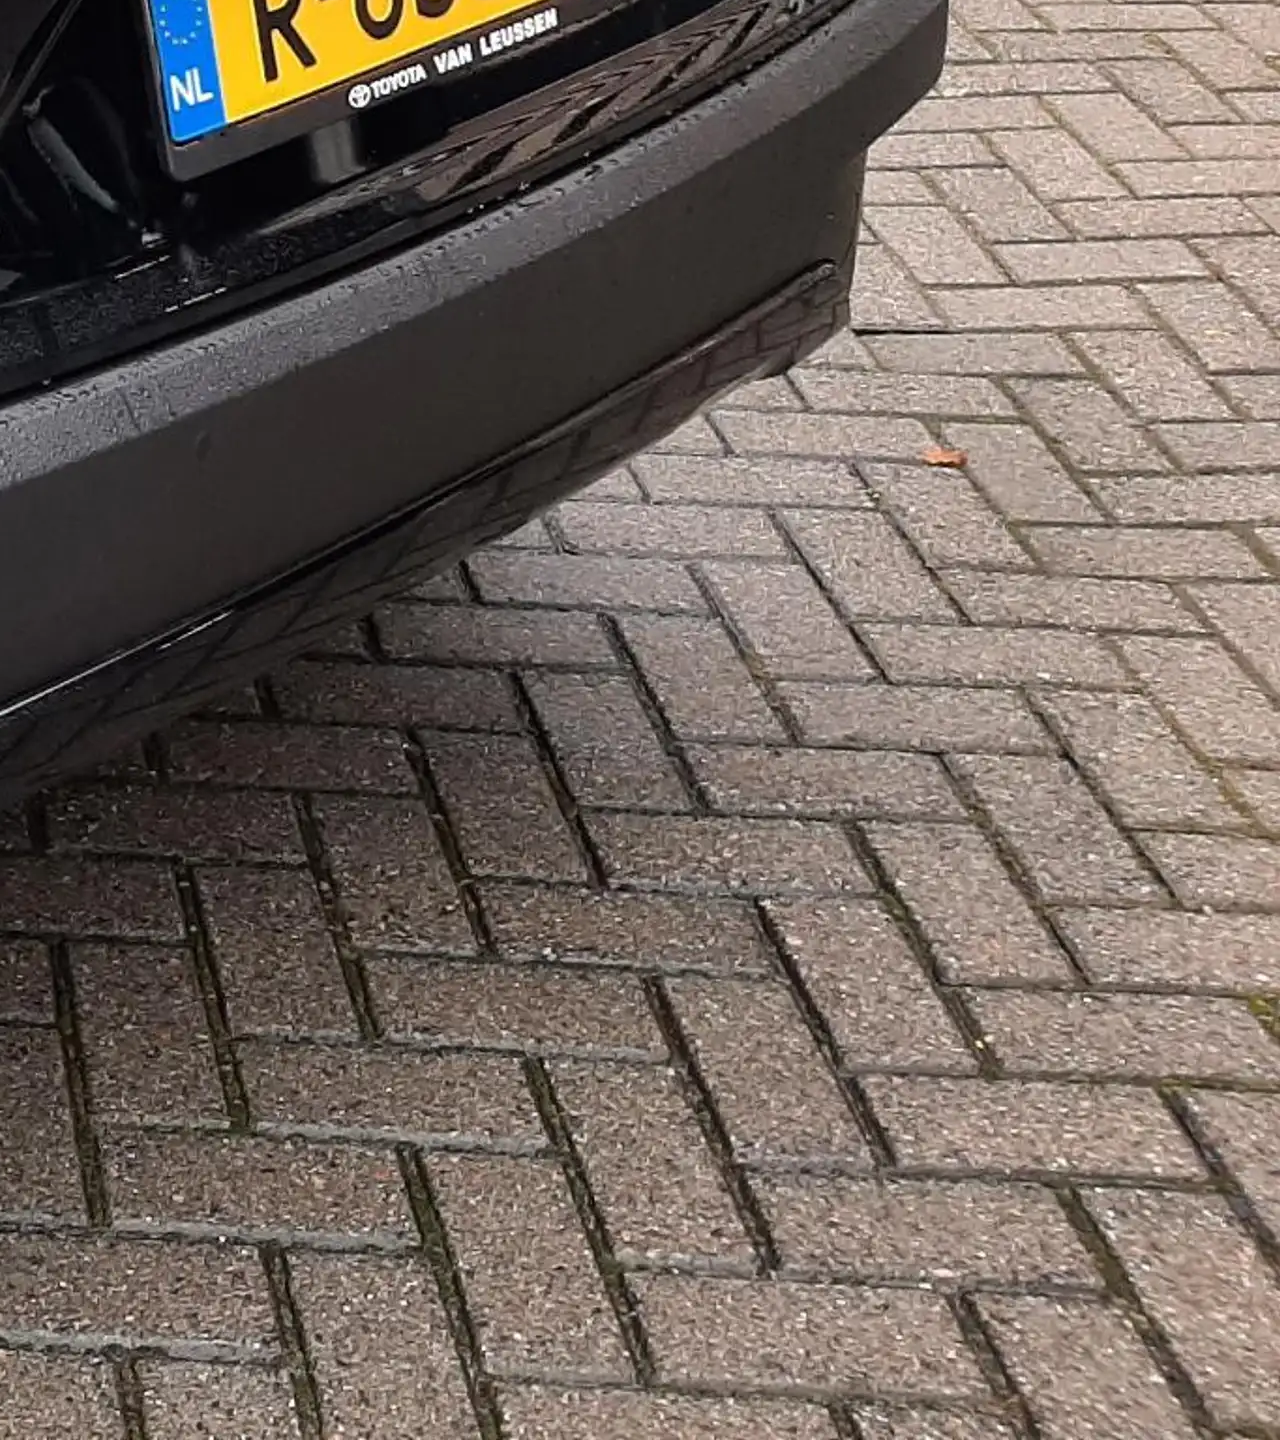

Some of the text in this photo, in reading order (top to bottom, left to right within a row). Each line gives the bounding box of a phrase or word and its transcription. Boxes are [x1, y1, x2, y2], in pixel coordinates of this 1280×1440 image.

[369, 8, 558, 98] TOYOTA VAN LEUSSEN
[170, 68, 214, 111] NL
